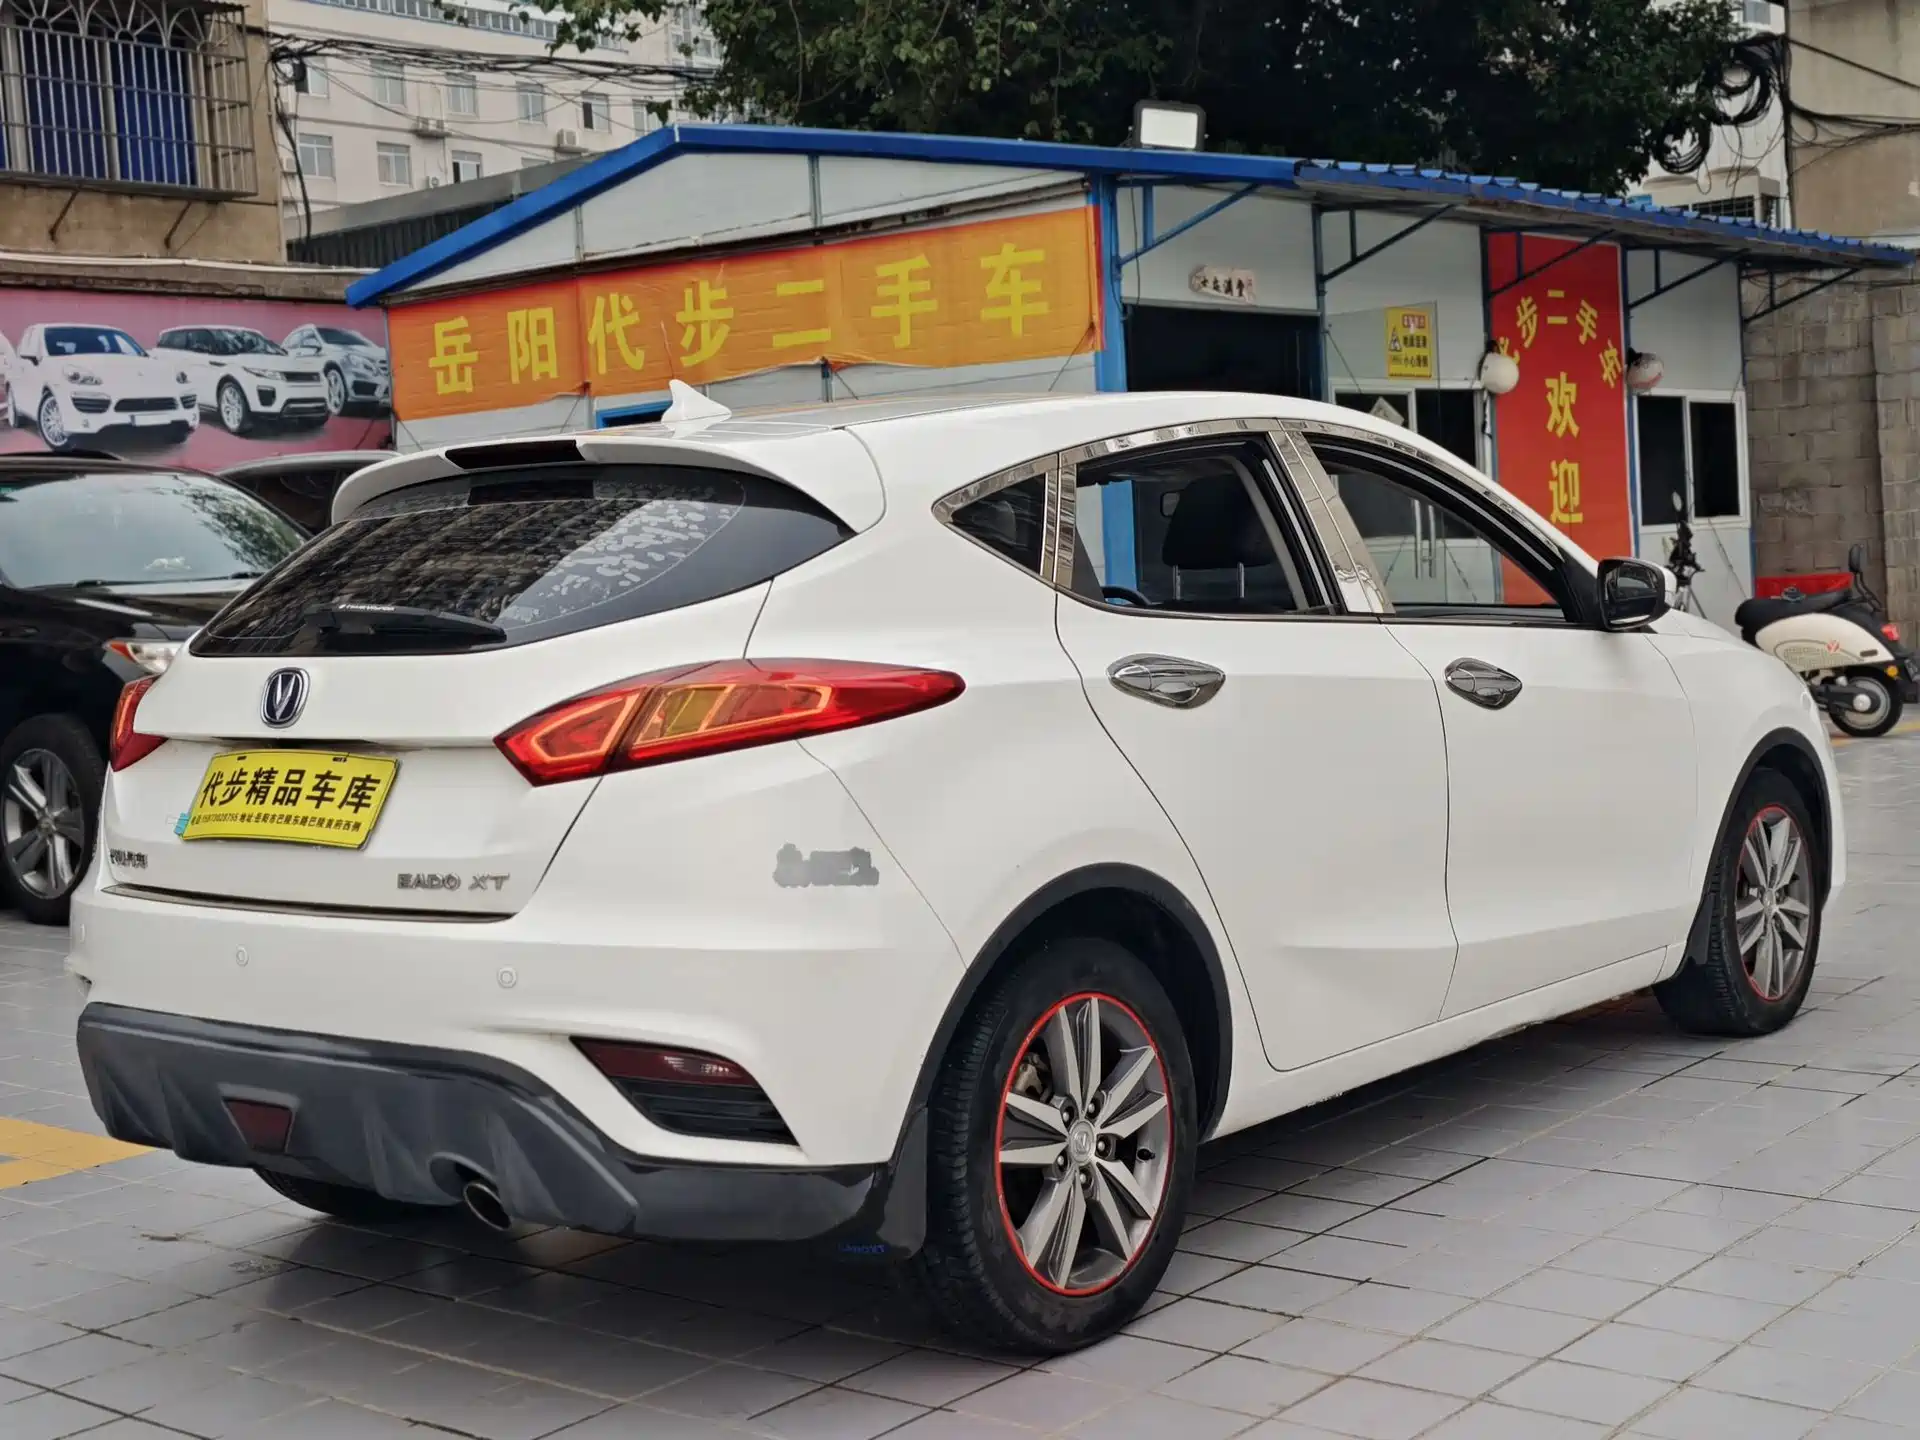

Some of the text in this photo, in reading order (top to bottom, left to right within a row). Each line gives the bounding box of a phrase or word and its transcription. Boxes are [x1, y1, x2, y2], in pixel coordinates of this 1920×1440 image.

[429, 243, 1049, 394] 岳阳代步二手车
[1545, 371, 1583, 524] 欢迎
[200, 766, 381, 814] 代步精品车库
[397, 872, 510, 891] EADO XT
